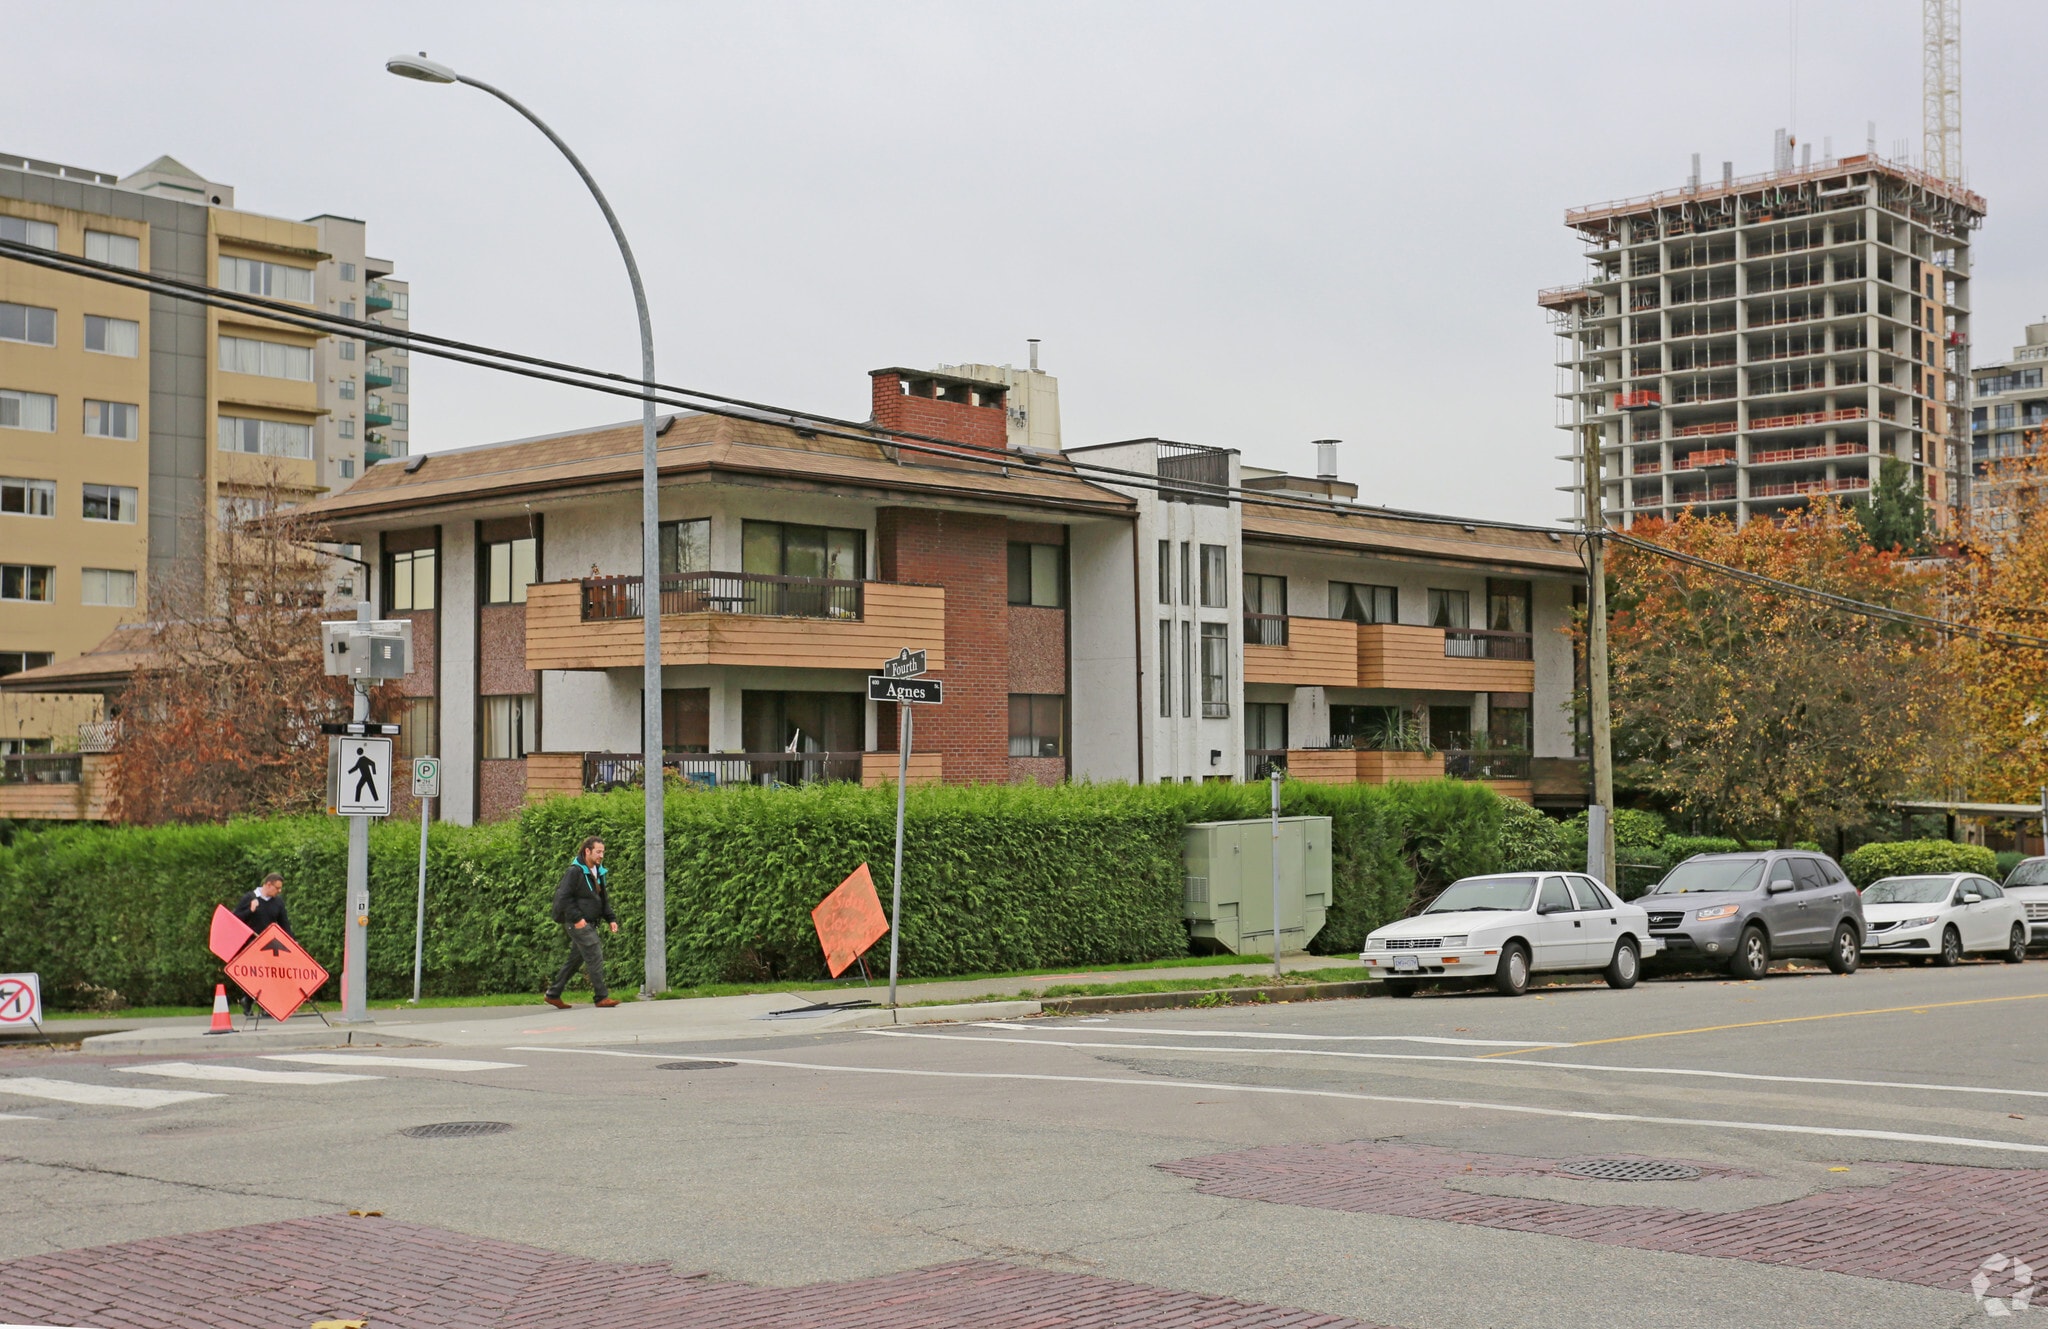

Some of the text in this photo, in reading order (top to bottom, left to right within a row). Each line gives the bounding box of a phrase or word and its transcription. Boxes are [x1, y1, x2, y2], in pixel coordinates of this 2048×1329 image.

[892, 658, 918, 676] Fourth
[886, 682, 926, 700] Agnes
[422, 766, 430, 774] P
[233, 965, 318, 980] CONSTRUCTION
